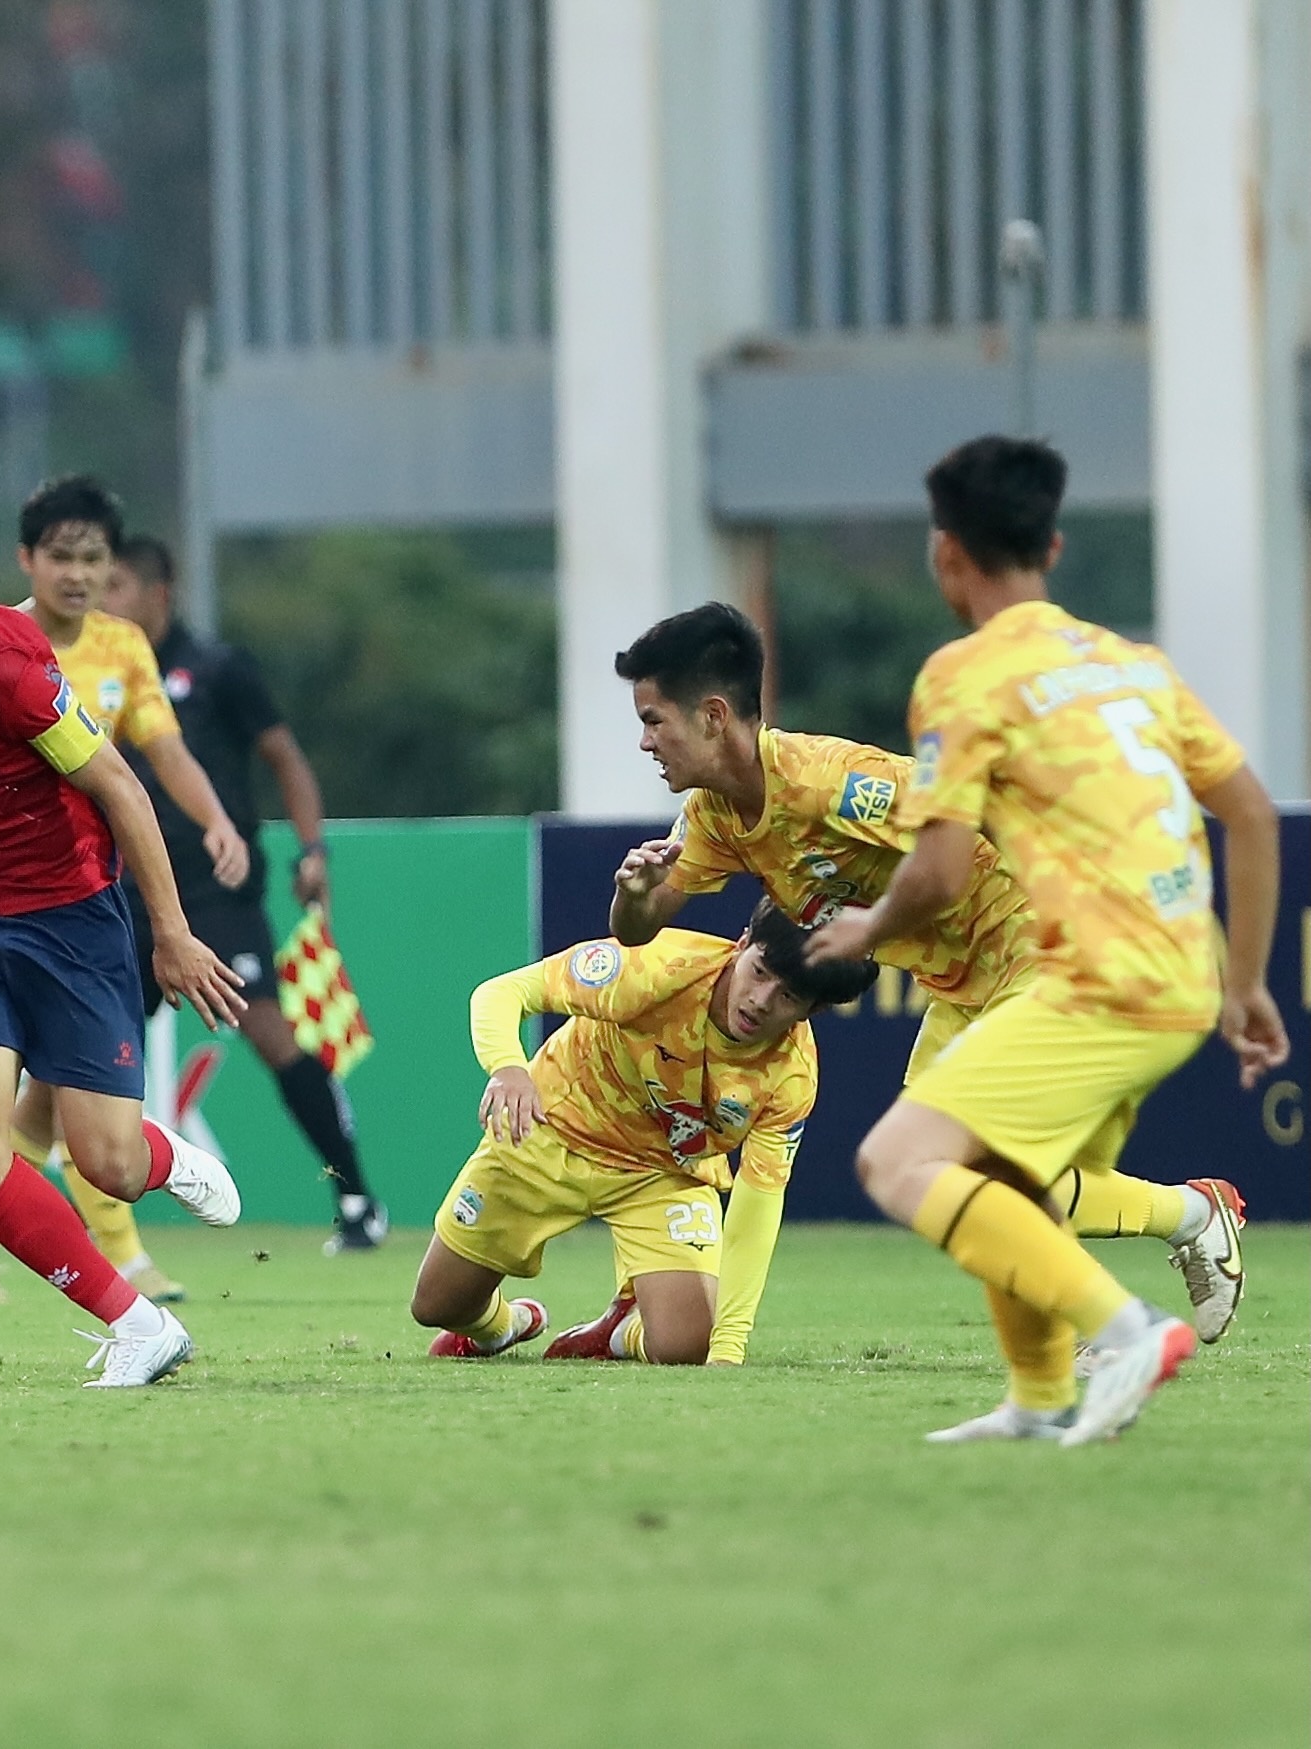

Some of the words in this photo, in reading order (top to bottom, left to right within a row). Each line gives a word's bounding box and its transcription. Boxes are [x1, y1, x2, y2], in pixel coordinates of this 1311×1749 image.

[1098, 696, 1191, 841] 5
[867, 780, 893, 822] TSN
[665, 1201, 719, 1242] 23
